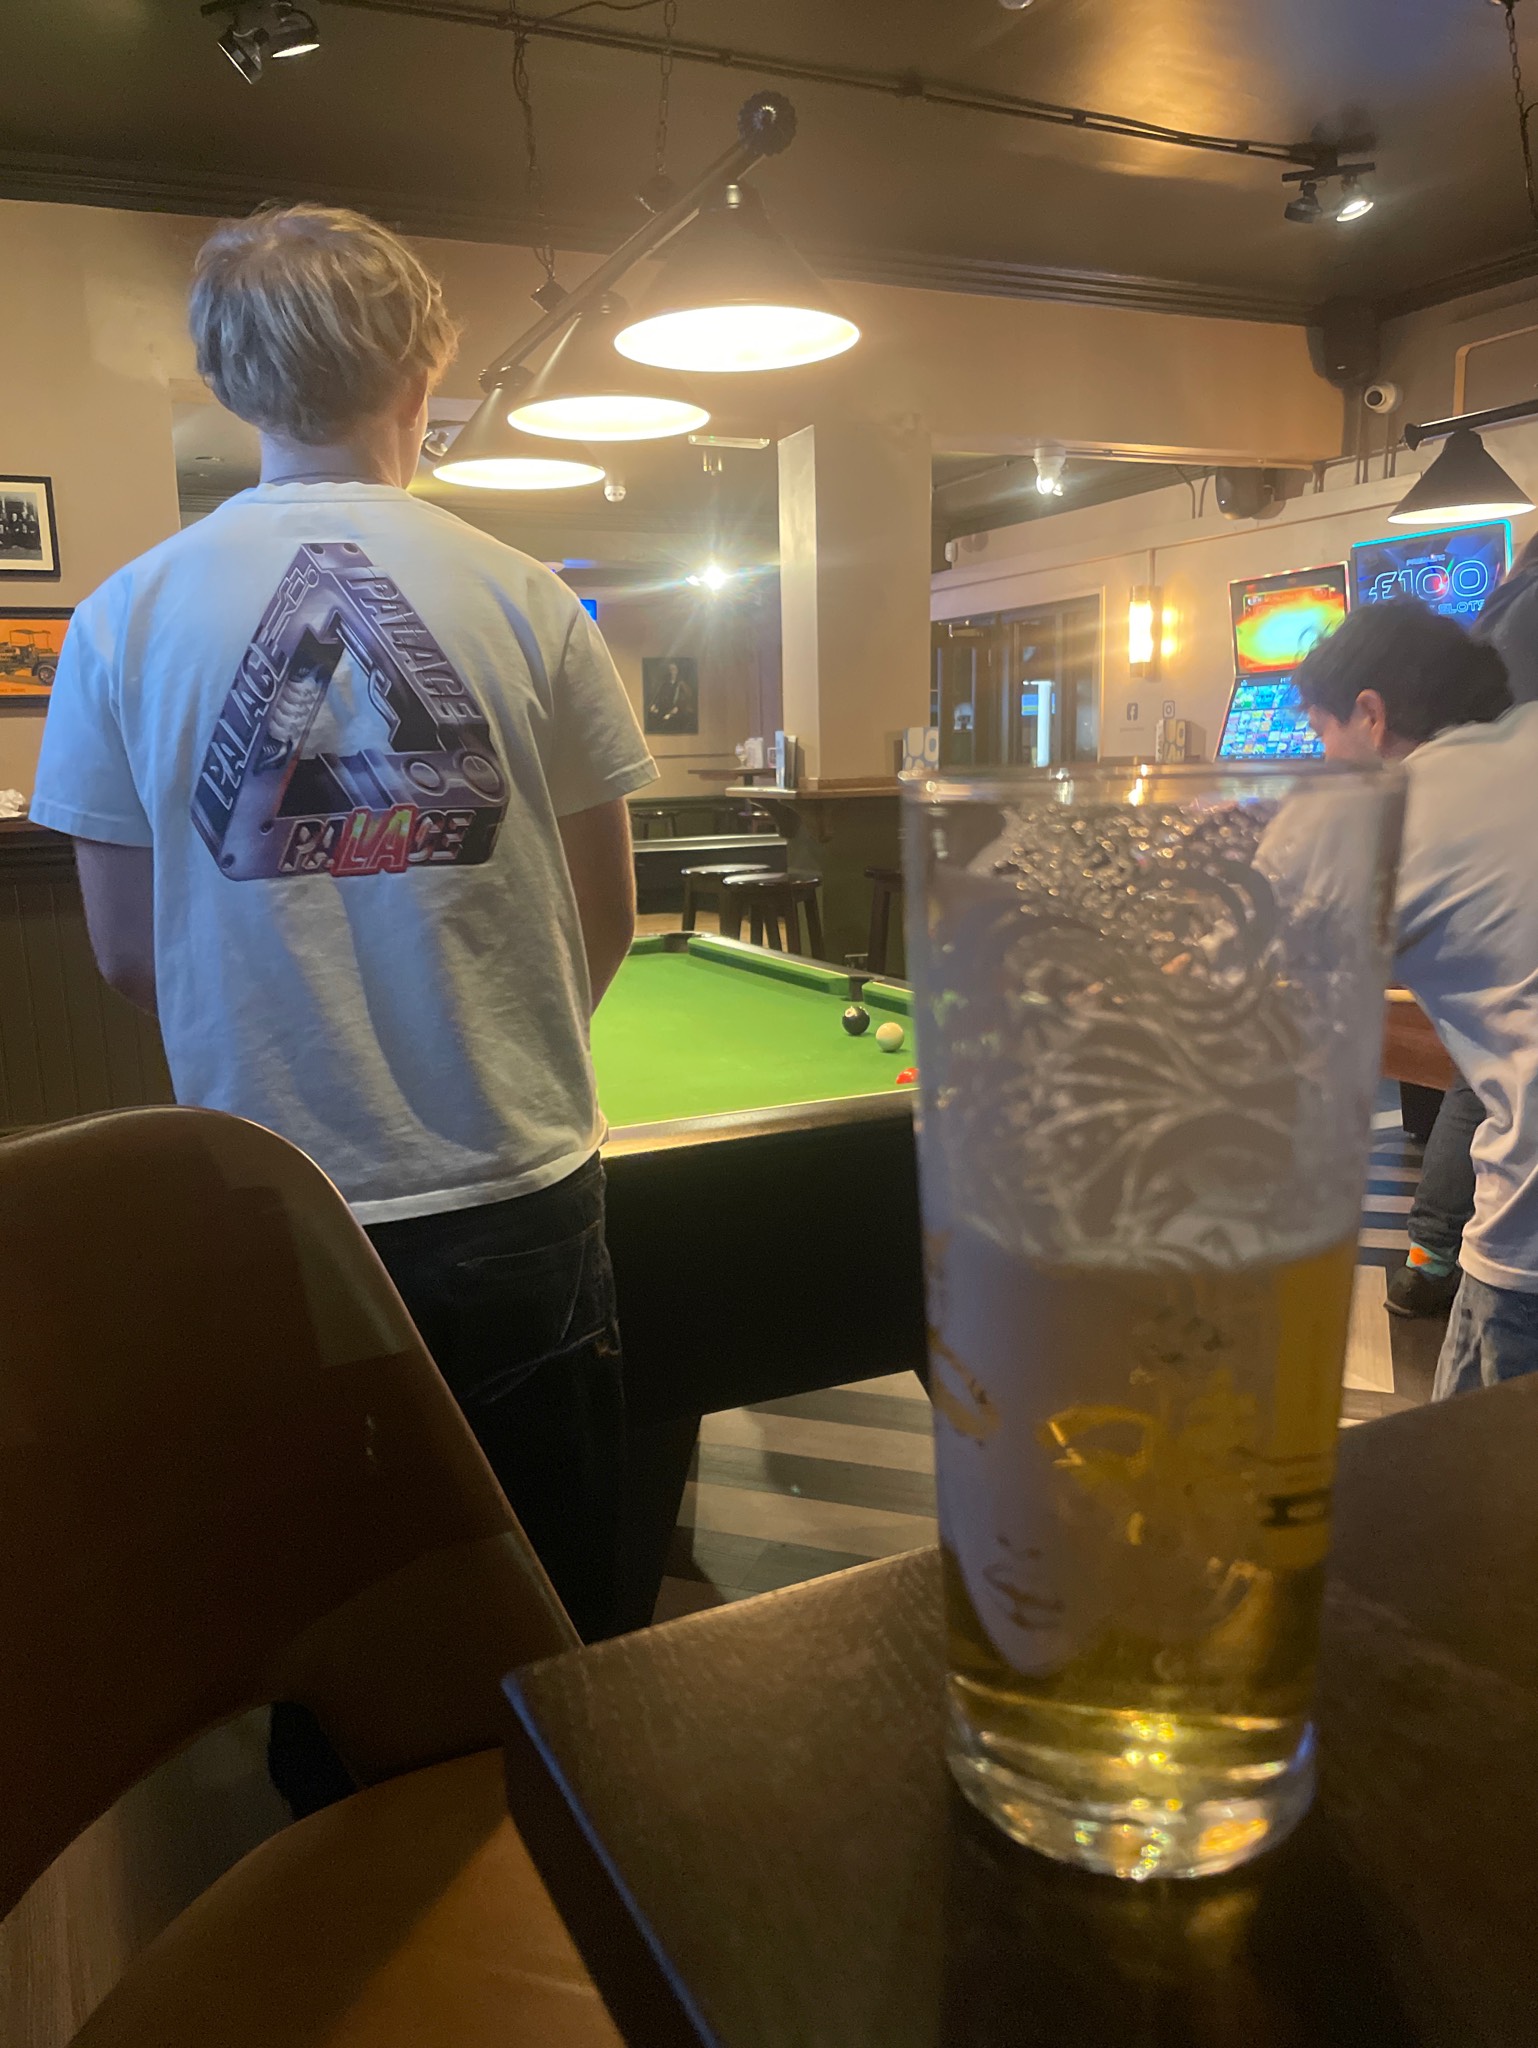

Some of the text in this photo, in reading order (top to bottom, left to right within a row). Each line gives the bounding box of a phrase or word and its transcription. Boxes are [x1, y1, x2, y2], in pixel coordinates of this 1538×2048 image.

[1369, 560, 1488, 604] £100
[346, 576, 482, 719] PALACE
[201, 643, 290, 811] PALACE
[278, 803, 477, 877] PALACE
